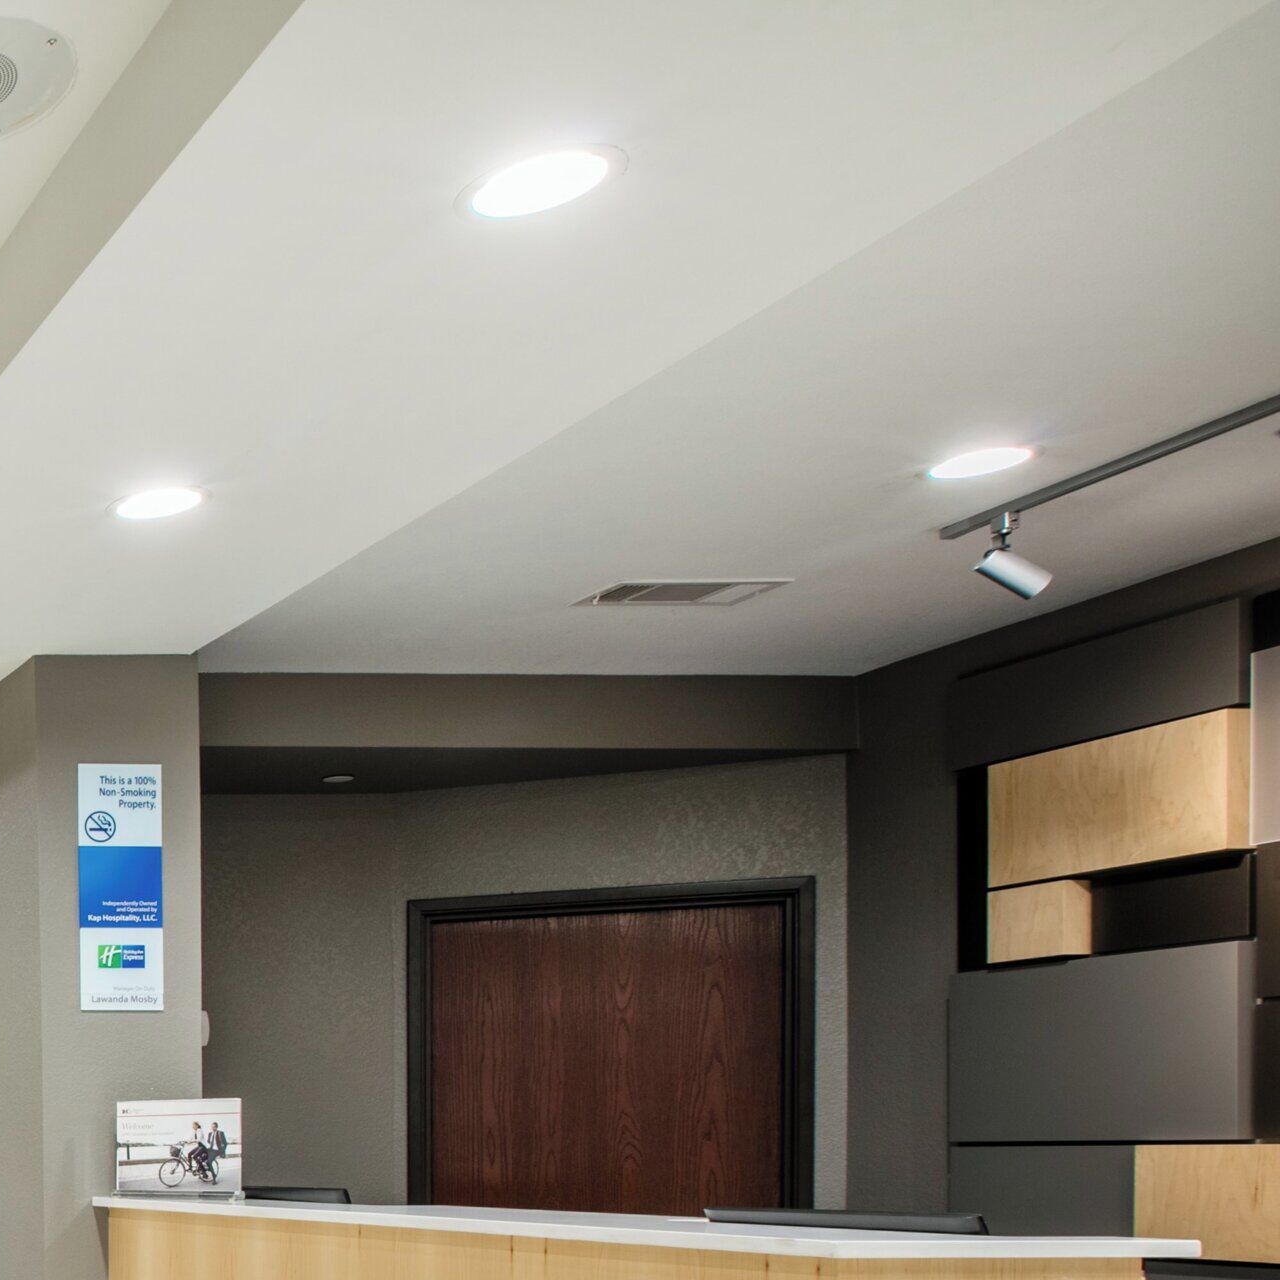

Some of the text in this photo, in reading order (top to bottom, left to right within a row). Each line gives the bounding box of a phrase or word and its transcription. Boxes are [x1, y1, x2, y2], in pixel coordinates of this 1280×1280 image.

[100, 776, 117, 785] This
[119, 776, 125, 785] is
[134, 776, 156, 785] 100%
[99, 788, 157, 799] Non-Smoking
[118, 800, 157, 810] Property.
[87, 914, 158, 923] Kap Hospitality, LLC.
[91, 995, 158, 1005] Lawanda Mosby
